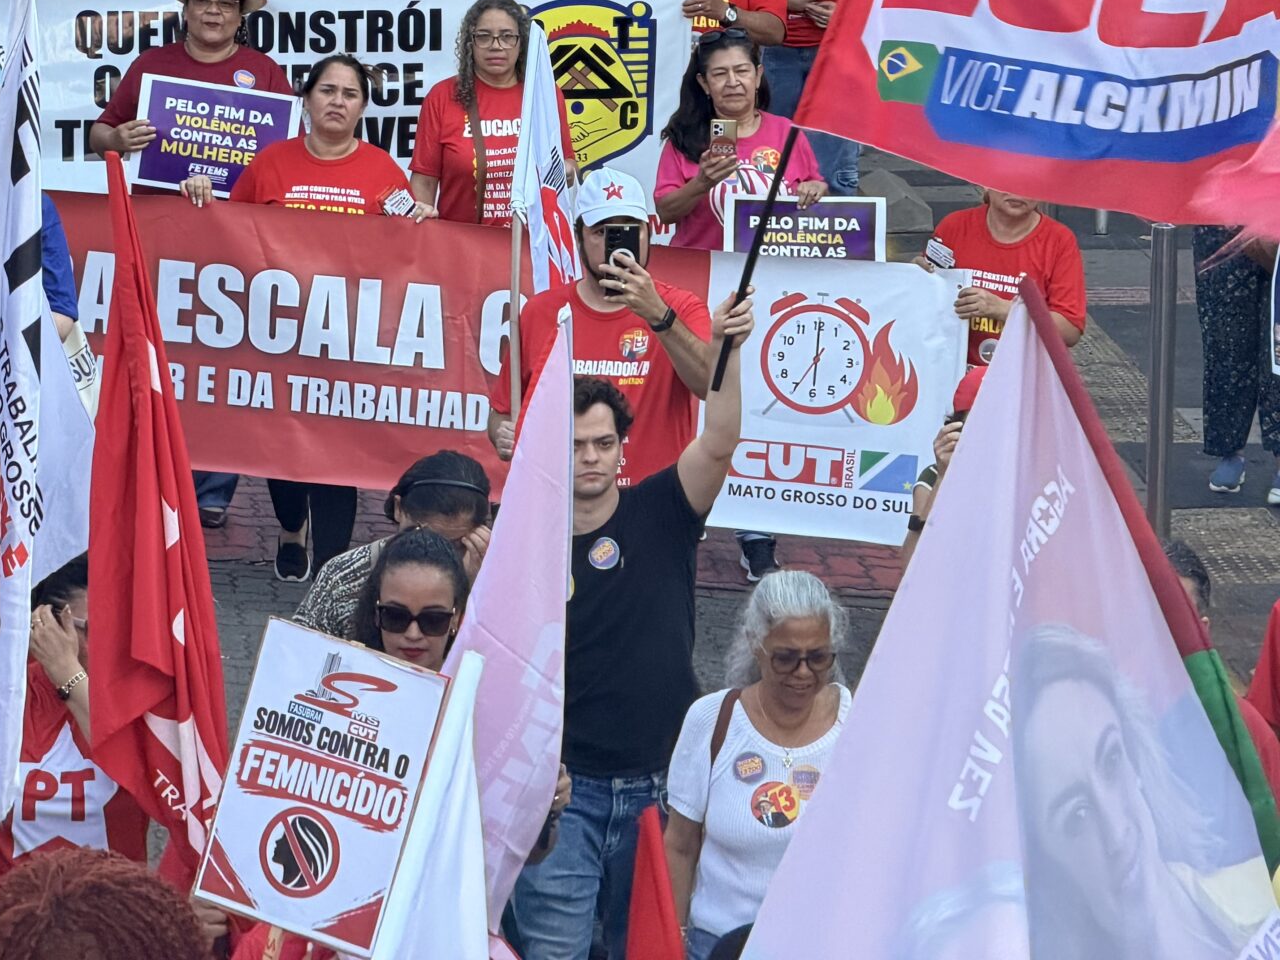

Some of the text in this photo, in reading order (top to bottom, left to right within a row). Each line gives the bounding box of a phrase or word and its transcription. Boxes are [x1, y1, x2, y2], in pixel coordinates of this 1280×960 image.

[940, 55, 1263, 135] VICE ALCKMIN
[164, 96, 274, 126] PELO FIM DA
[175, 113, 257, 138] VIOLÊNCIA
[170, 127, 235, 149] CONTRA
[236, 136, 258, 151] AS
[160, 139, 256, 167] MULHERE
[187, 161, 229, 178] FETEMS
[798, 216, 861, 231] FIM DA
[763, 230, 844, 245] VIOLÊNCIA
[758, 245, 847, 258] CONTRA AS
[156, 258, 447, 370] ESCALA
[782, 334, 796, 347] 10
[796, 322, 806, 335] 11
[197, 365, 491, 432] E DA TRABALHAD
[731, 440, 856, 489] CUT BRASIL
[727, 482, 914, 515] MATO GROSSO DO SUL
[350, 710, 380, 727] MS
[253, 706, 410, 780] SOMOS CONTRA O
[348, 724, 377, 742] CUT
[21, 767, 96, 823] PT
[243, 745, 405, 828] FEMINICÍDIO
